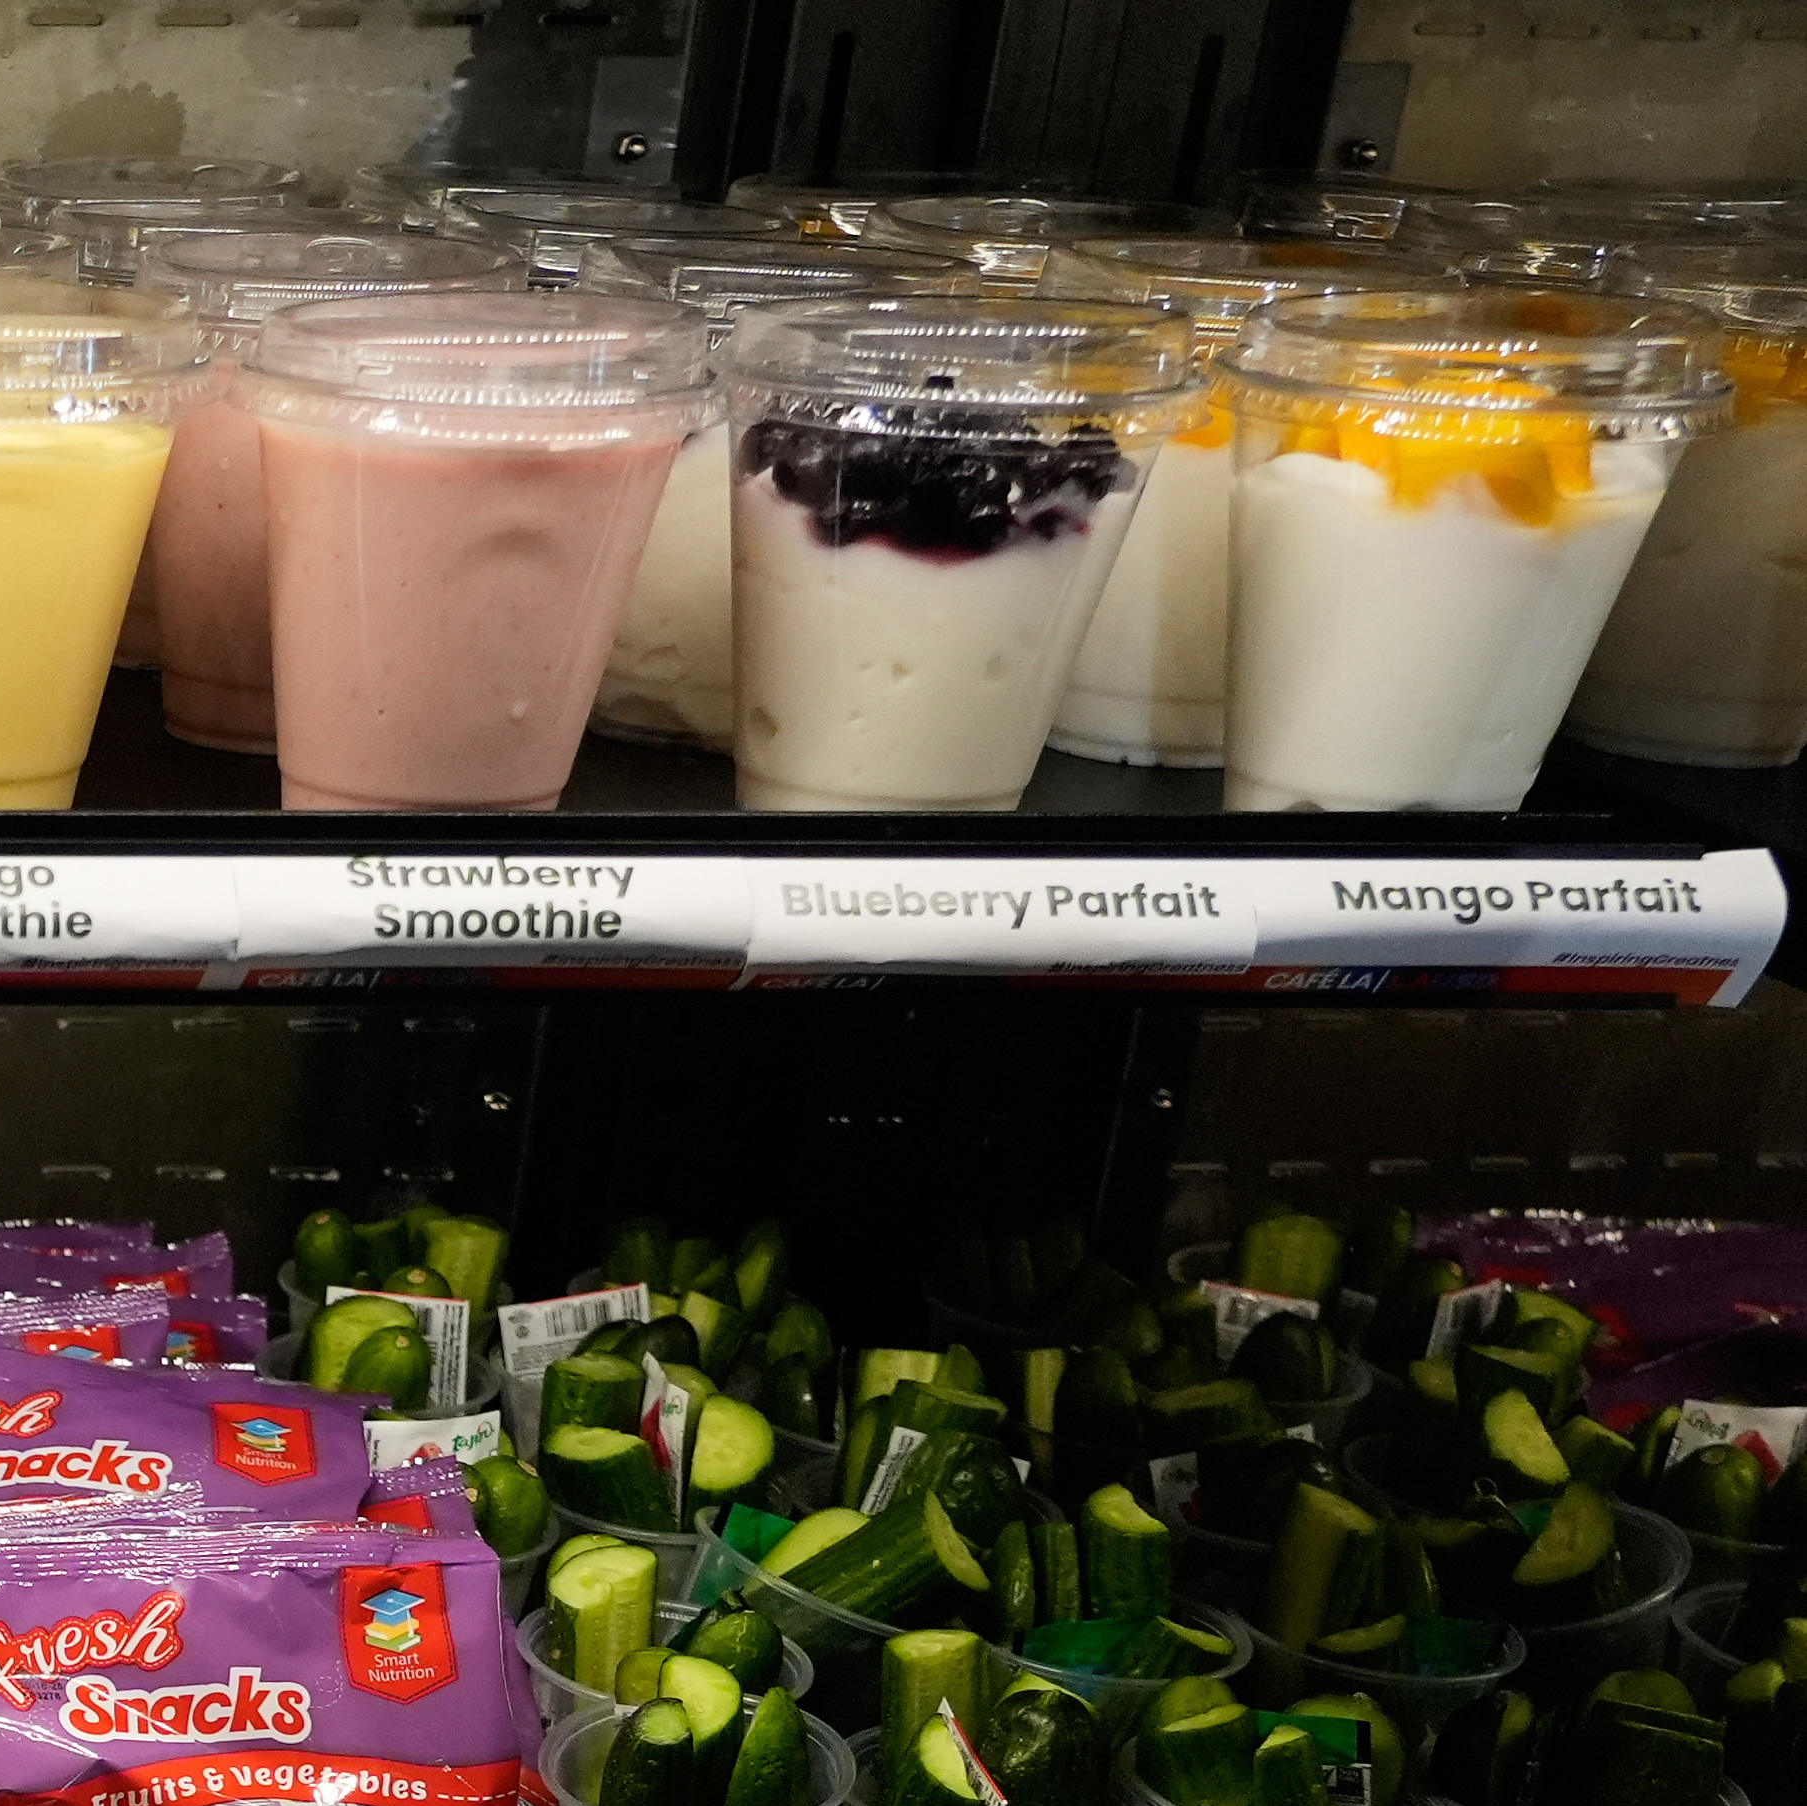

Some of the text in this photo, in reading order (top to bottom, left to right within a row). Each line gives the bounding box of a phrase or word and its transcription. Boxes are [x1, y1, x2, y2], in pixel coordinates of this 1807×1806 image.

[346, 857, 634, 898] Strawberry
[374, 901, 623, 939] Smoothie
[781, 882, 1220, 930] Blueberry Parfait
[1332, 878, 1702, 925] Mango Parfait
[235, 1454, 297, 1470] Nutrition
[367, 1666, 435, 1683] Nutrition
[374, 1652, 420, 1668] Smart
[65, 1671, 308, 1739] Snacks
[202, 1767, 225, 1792] &
